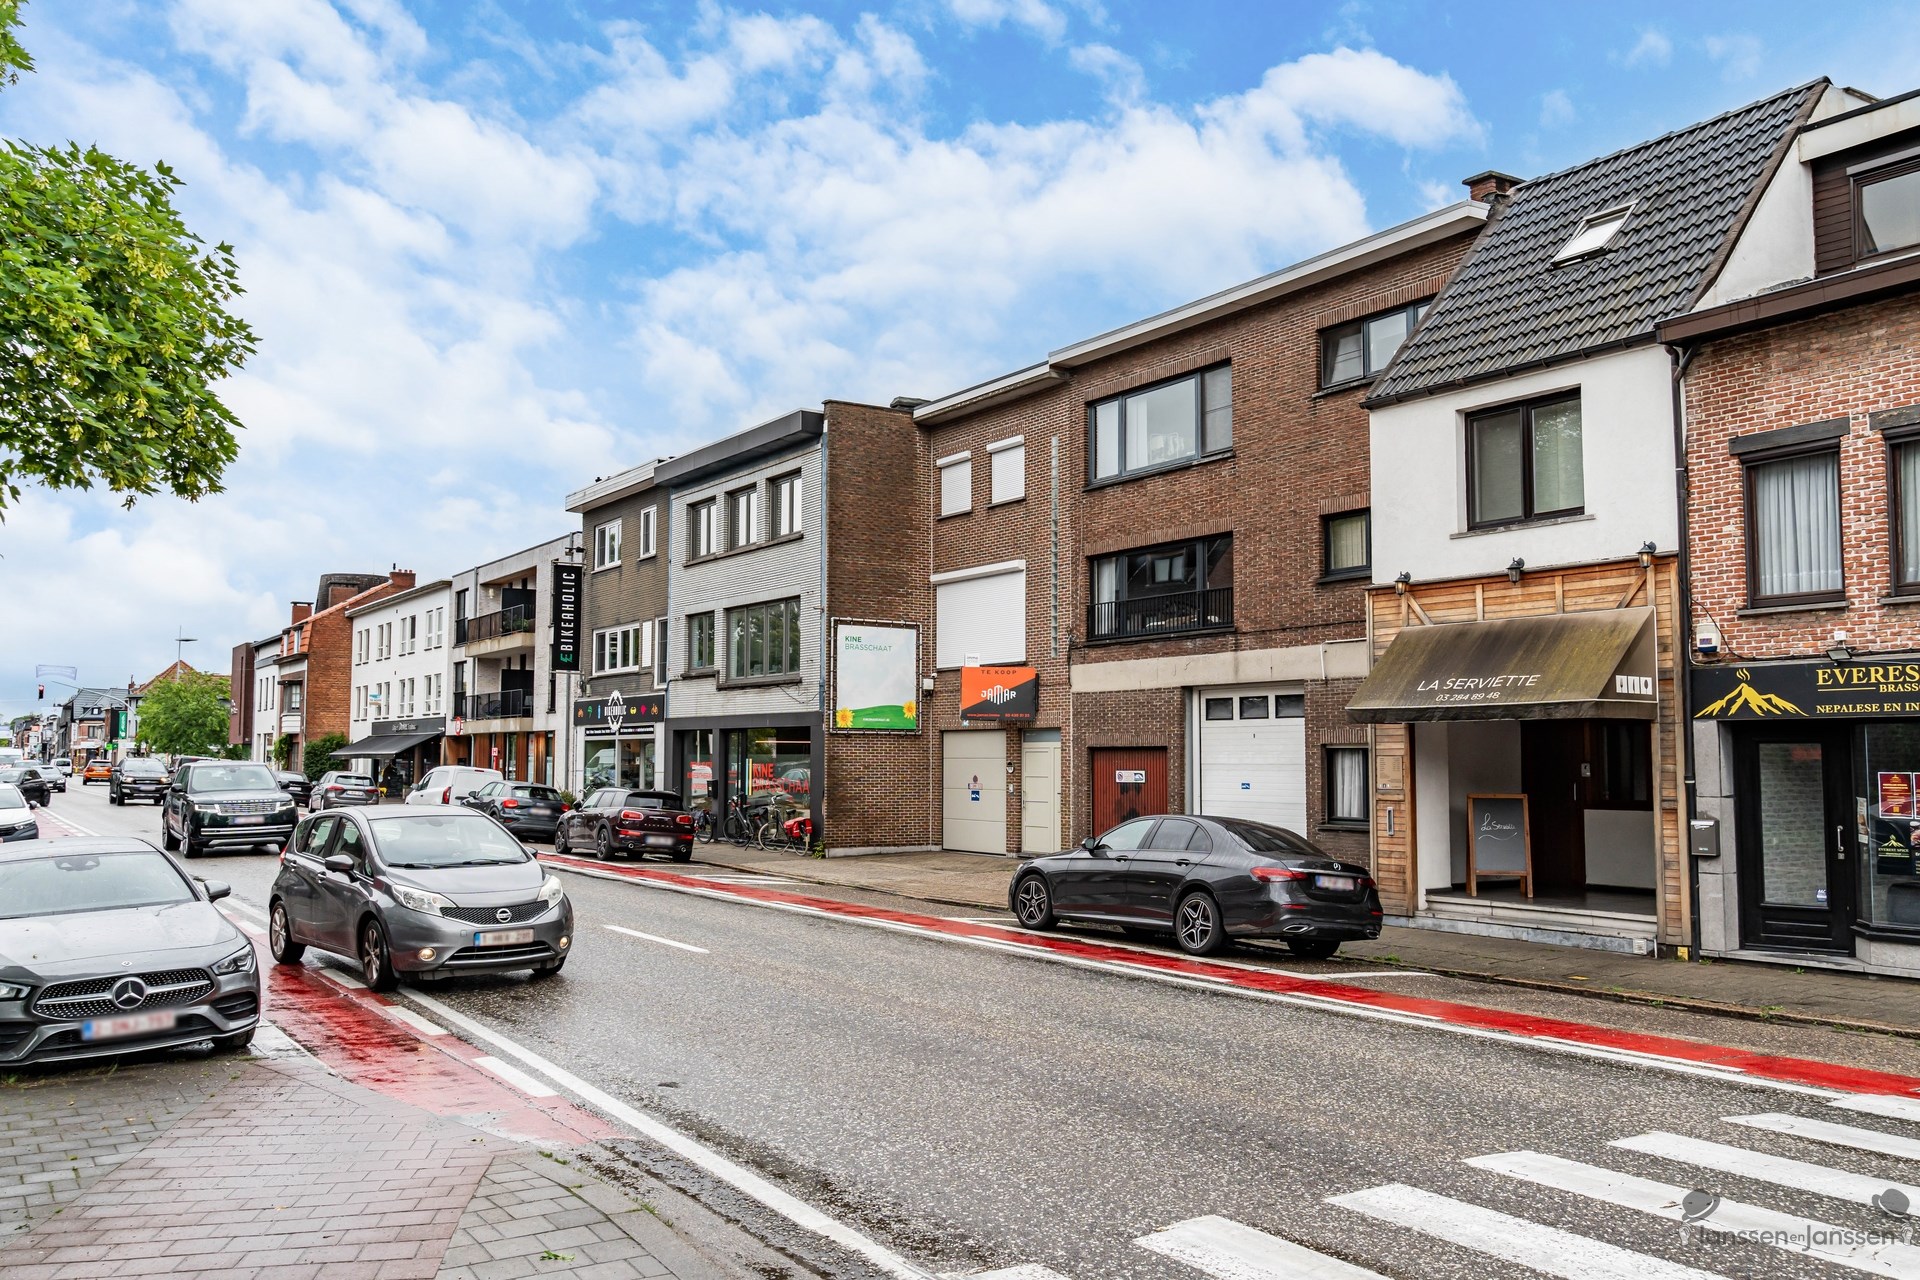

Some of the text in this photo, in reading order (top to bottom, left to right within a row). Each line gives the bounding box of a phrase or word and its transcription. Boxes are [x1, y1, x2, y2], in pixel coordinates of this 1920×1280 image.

[844, 635, 862, 643] KINE
[844, 643, 893, 652] BRASSCHAAT
[1816, 664, 1920, 685] EVERES
[1417, 674, 1541, 691] LA SERVIETTE
[1879, 682, 1920, 693] BRASS
[980, 684, 1017, 705] JAMAR
[1435, 691, 1501, 702] 03 284 89 48
[1815, 703, 1880, 714] NEPALESE
[1883, 702, 1901, 712] EN
[752, 763, 774, 778] KINE
